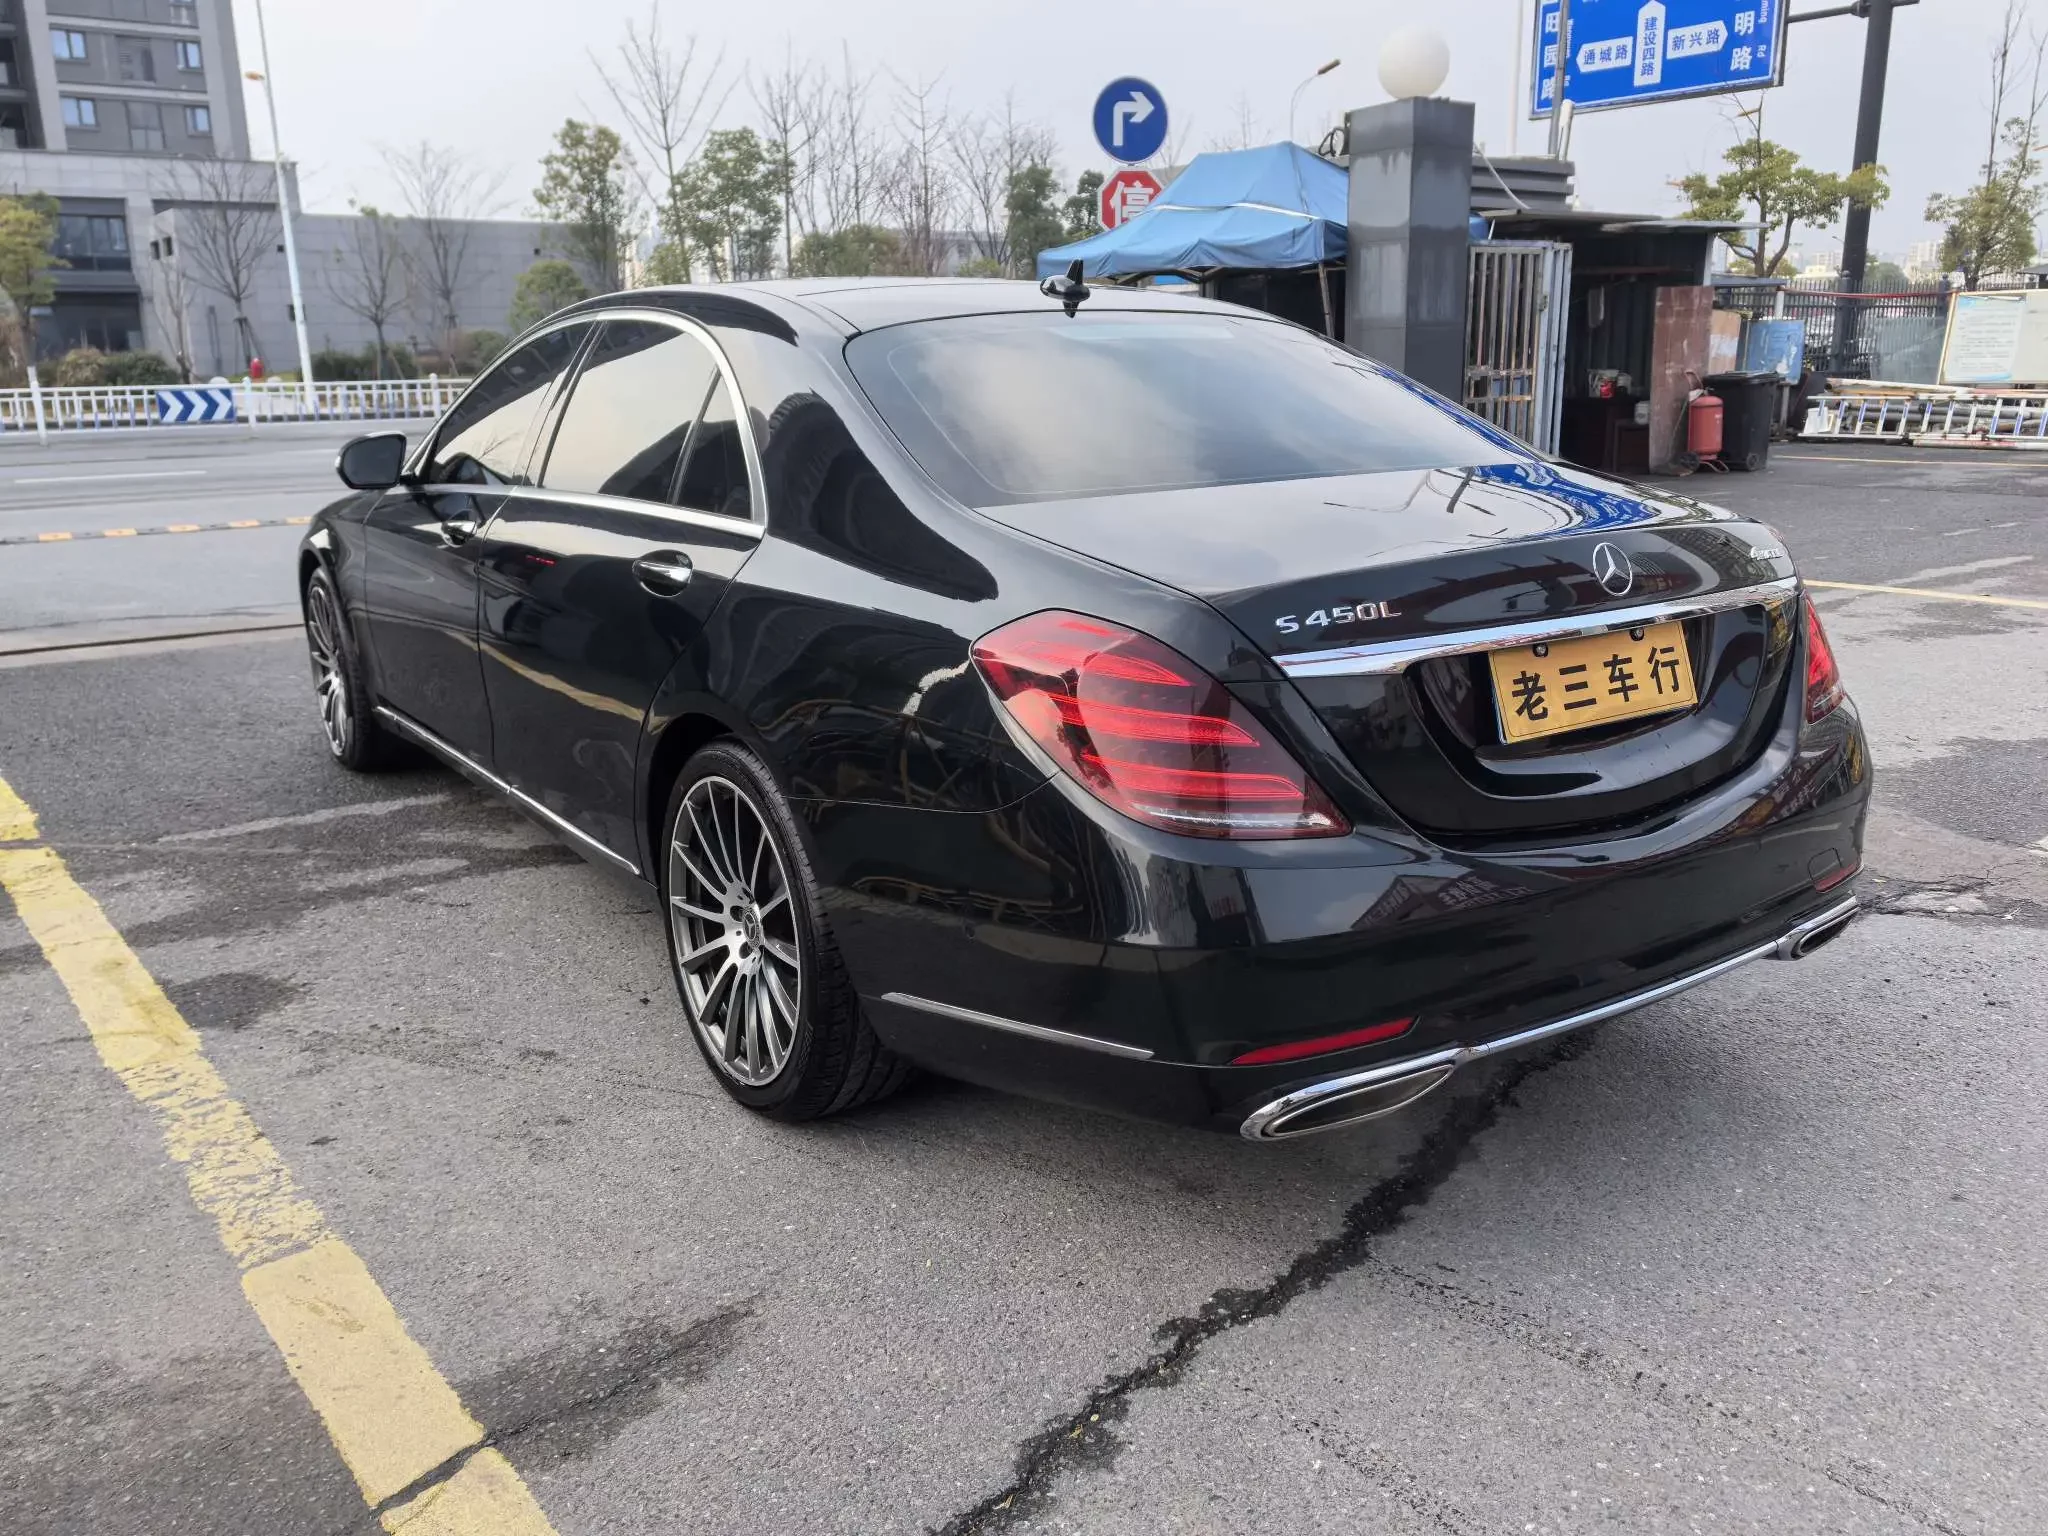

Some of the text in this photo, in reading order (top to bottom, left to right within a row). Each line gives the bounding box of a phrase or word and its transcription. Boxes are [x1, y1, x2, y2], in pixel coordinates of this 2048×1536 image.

[1584, 44, 1629, 65] 通城路
[1640, 16, 1658, 77] 建设四路
[1671, 28, 1721, 52] 新兴路
[1757, 44, 1767, 58] Rd
[1109, 180, 1154, 228] 停
[1275, 601, 1402, 634] S 450L
[1511, 646, 1680, 721] 老三车行
